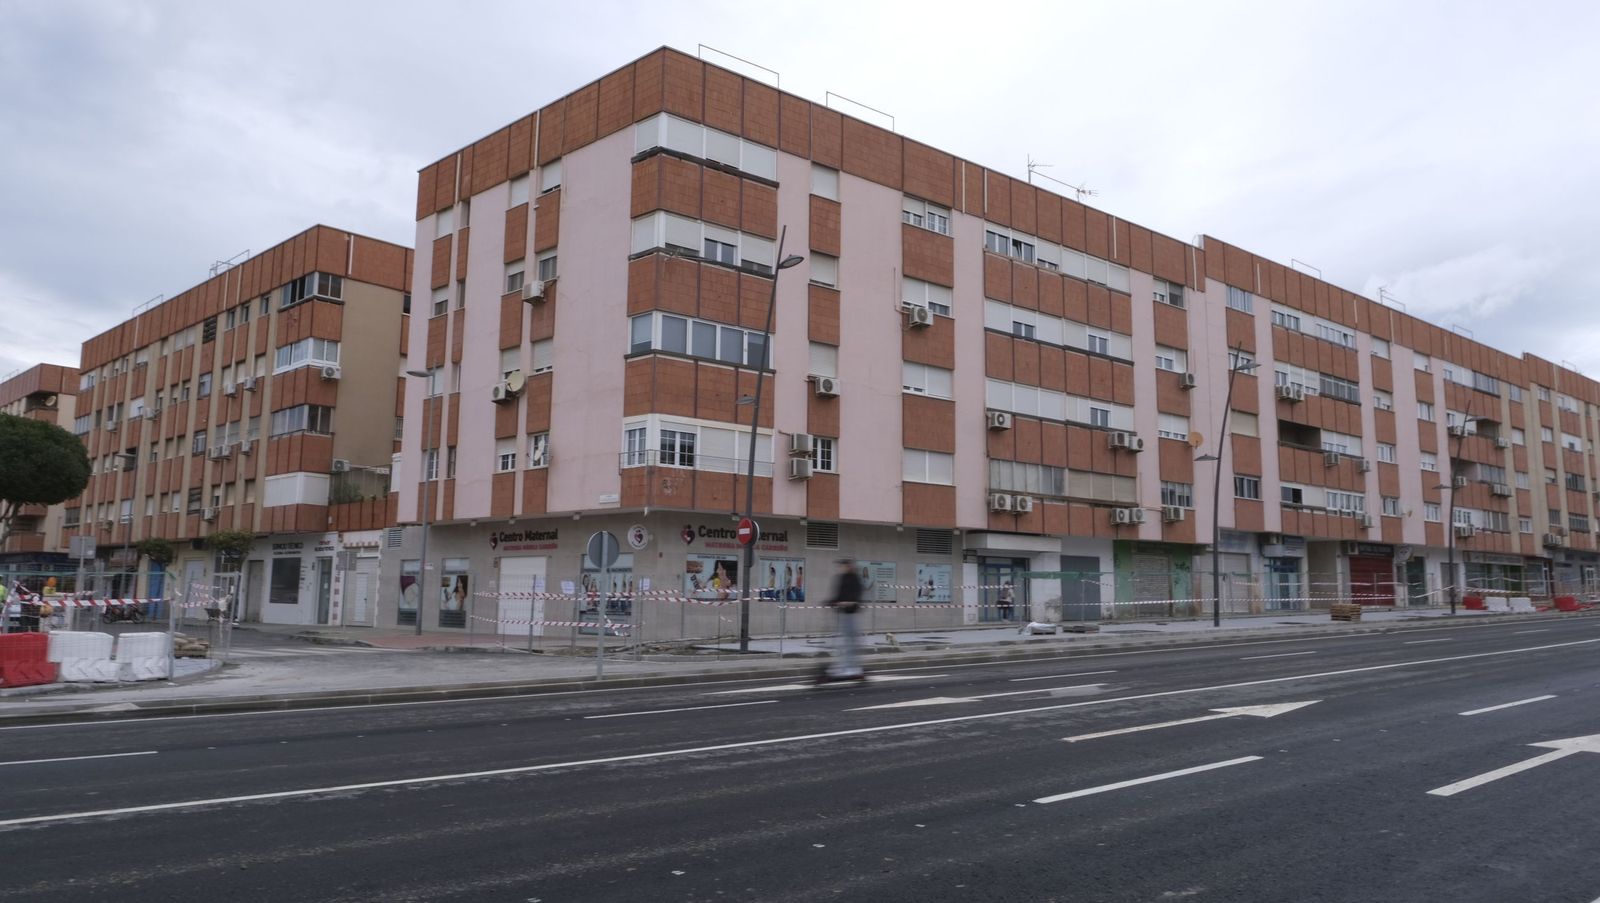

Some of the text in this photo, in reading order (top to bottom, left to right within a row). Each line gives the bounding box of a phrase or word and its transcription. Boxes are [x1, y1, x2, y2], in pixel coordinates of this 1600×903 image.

[499, 528, 558, 542] Centro Maternal
[698, 525, 736, 538] Centro
